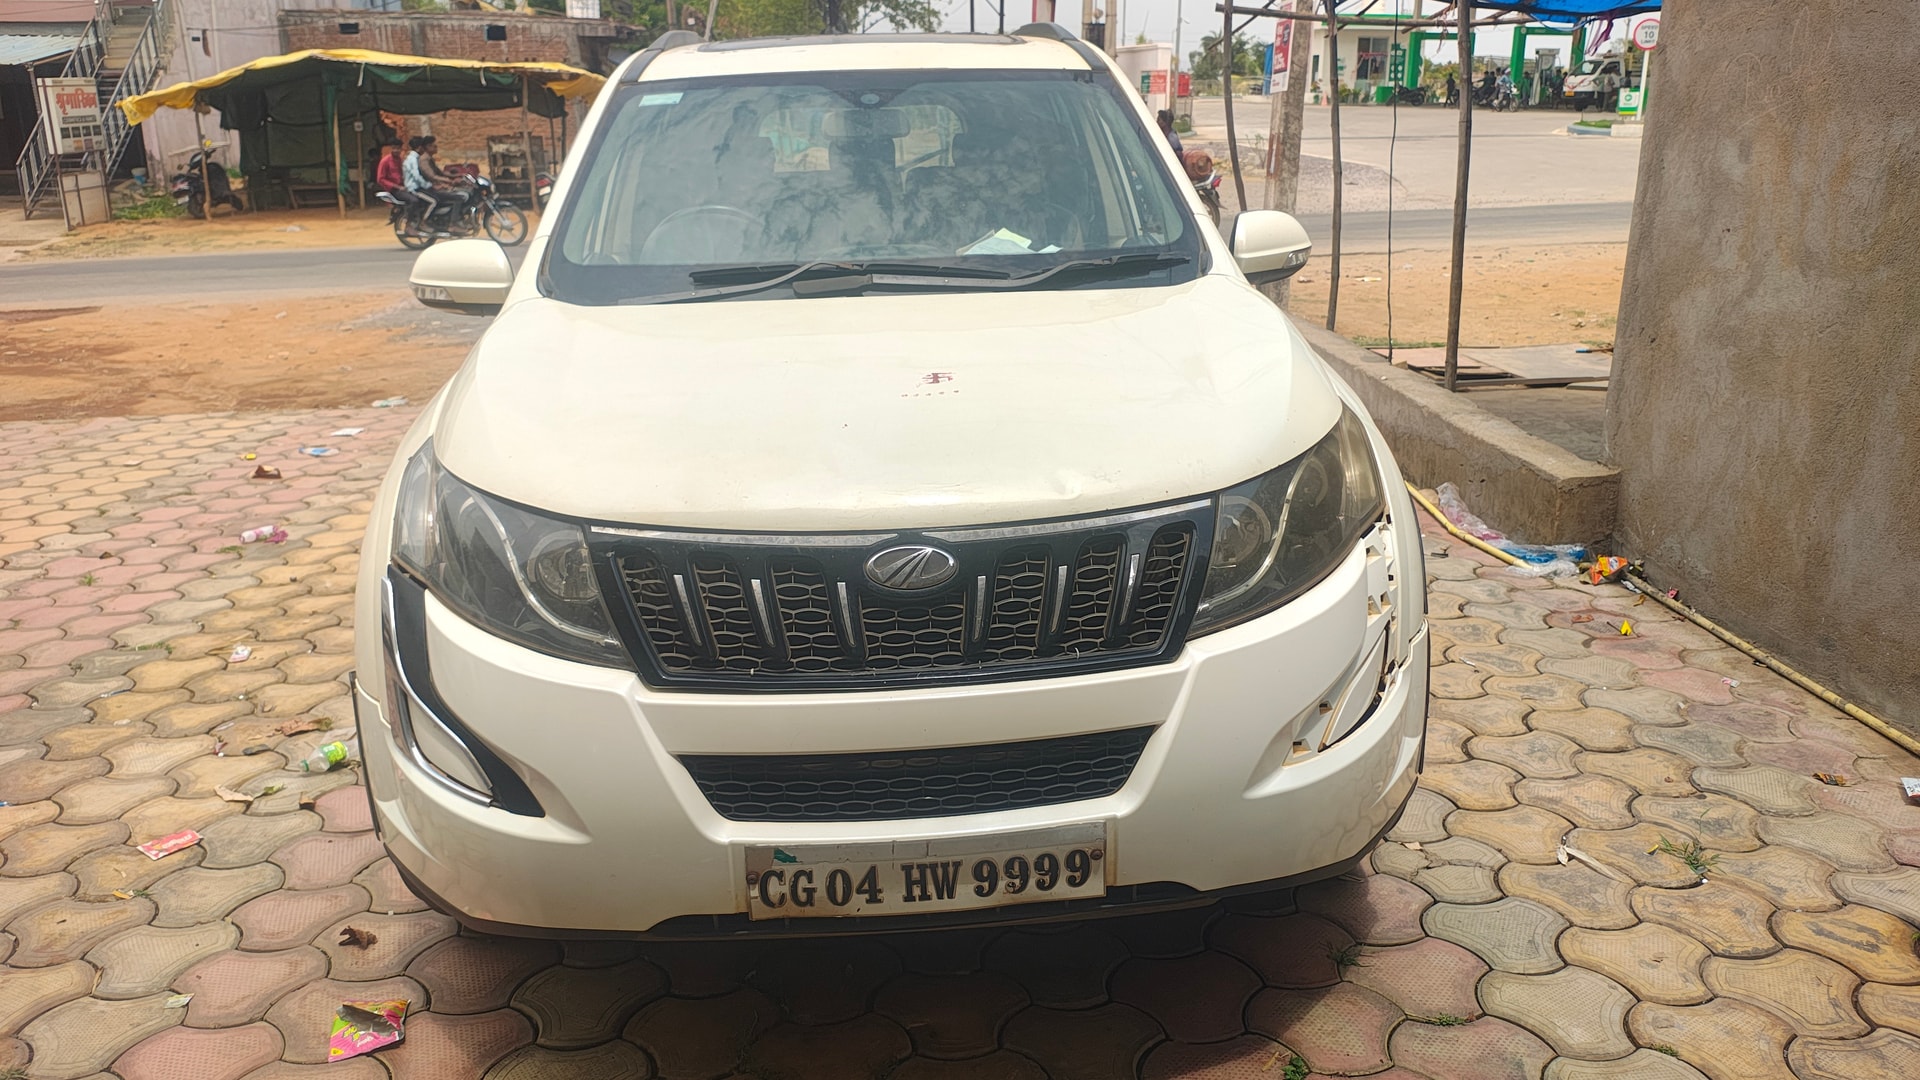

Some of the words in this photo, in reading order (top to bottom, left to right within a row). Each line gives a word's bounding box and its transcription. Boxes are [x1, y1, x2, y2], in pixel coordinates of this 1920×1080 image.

[1644, 31, 1655, 39] 10
[759, 868, 817, 909] CG
[825, 864, 884, 906] 04
[901, 859, 963, 902] HW
[971, 848, 1091, 898] 9999
